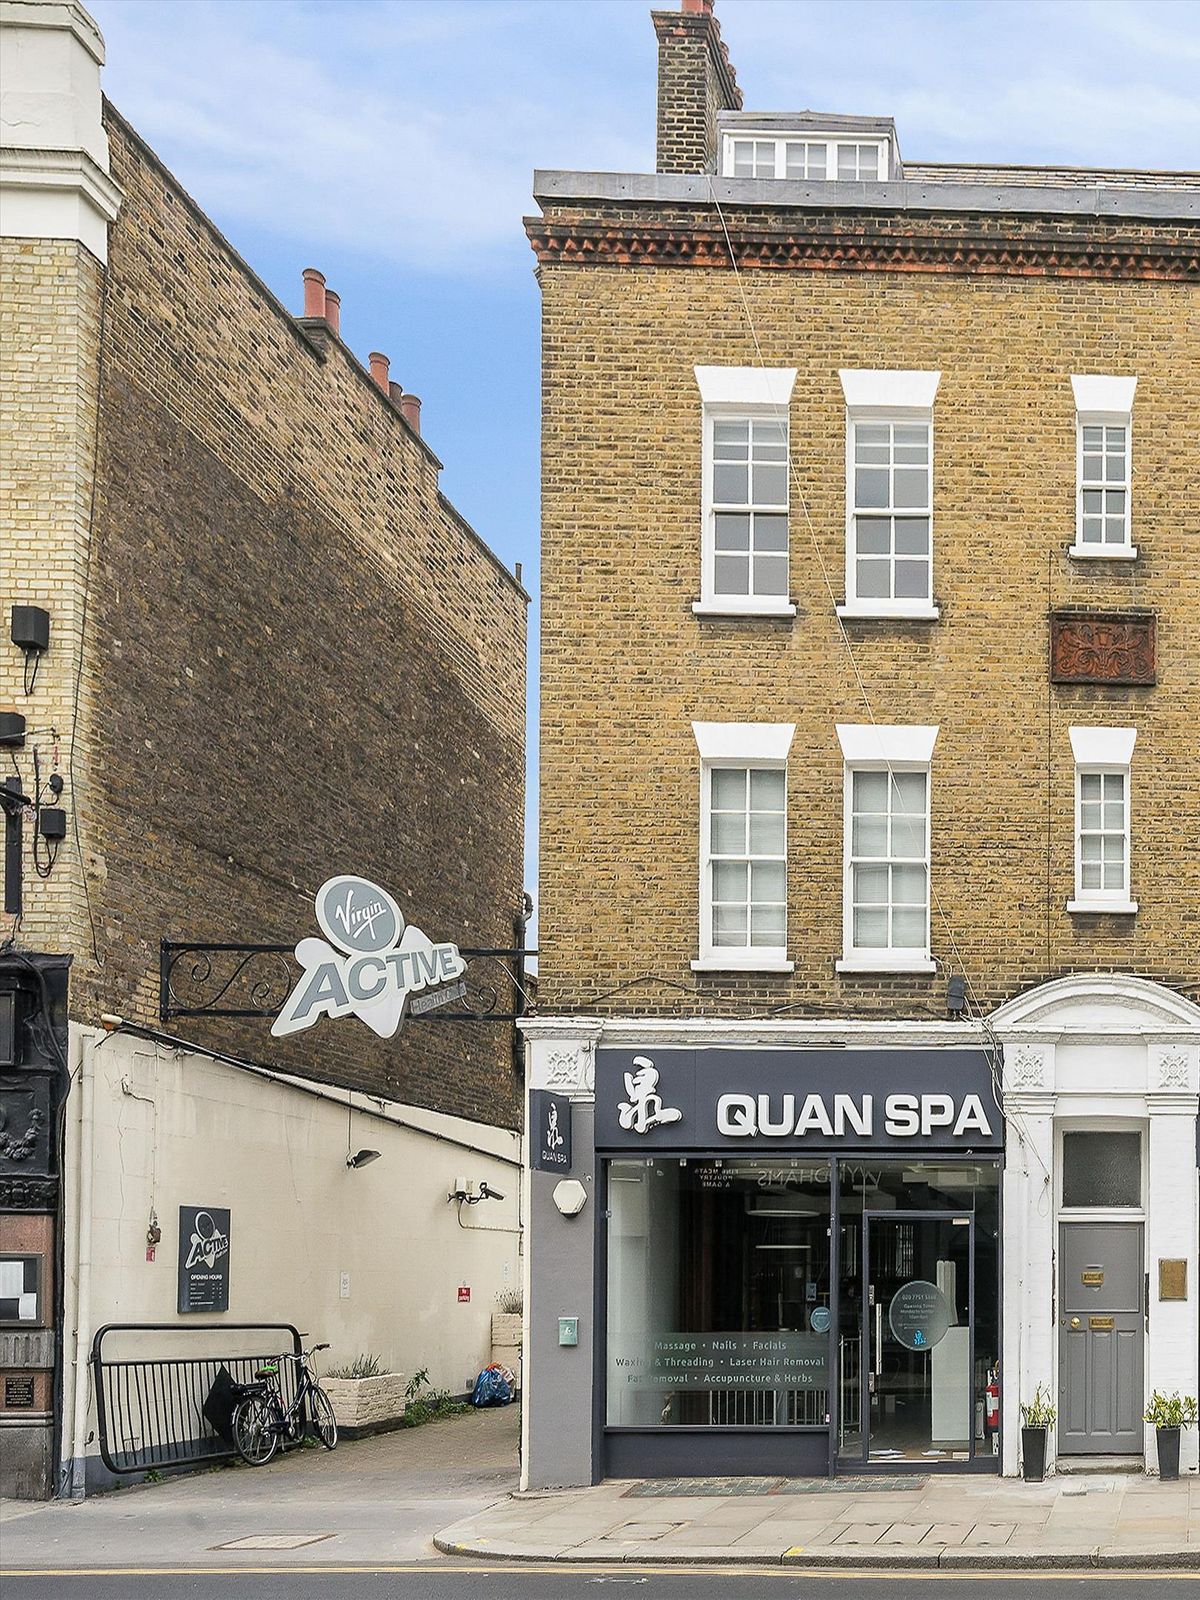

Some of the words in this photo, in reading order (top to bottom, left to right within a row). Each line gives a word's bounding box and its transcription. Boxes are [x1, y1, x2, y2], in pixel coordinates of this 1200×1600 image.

[335, 889, 387, 940] Virgin
[290, 947, 457, 1022] ACTIVE
[717, 1093, 873, 1137] QUAN
[884, 1093, 993, 1137] SPA
[542, 1150, 557, 1162] QUAN
[557, 1152, 567, 1164] SPA
[654, 1341, 697, 1351] Massage
[712, 1341, 737, 1350] Nails
[753, 1341, 787, 1350] Facials
[664, 1357, 714, 1368] Threading
[730, 1357, 757, 1367] Laser
[759, 1357, 780, 1367] Hair
[783, 1357, 825, 1367] Removal
[703, 1374, 771, 1384] Accupuncture
[774, 1374, 781, 1383] &
[784, 1374, 813, 1383] Herbs
